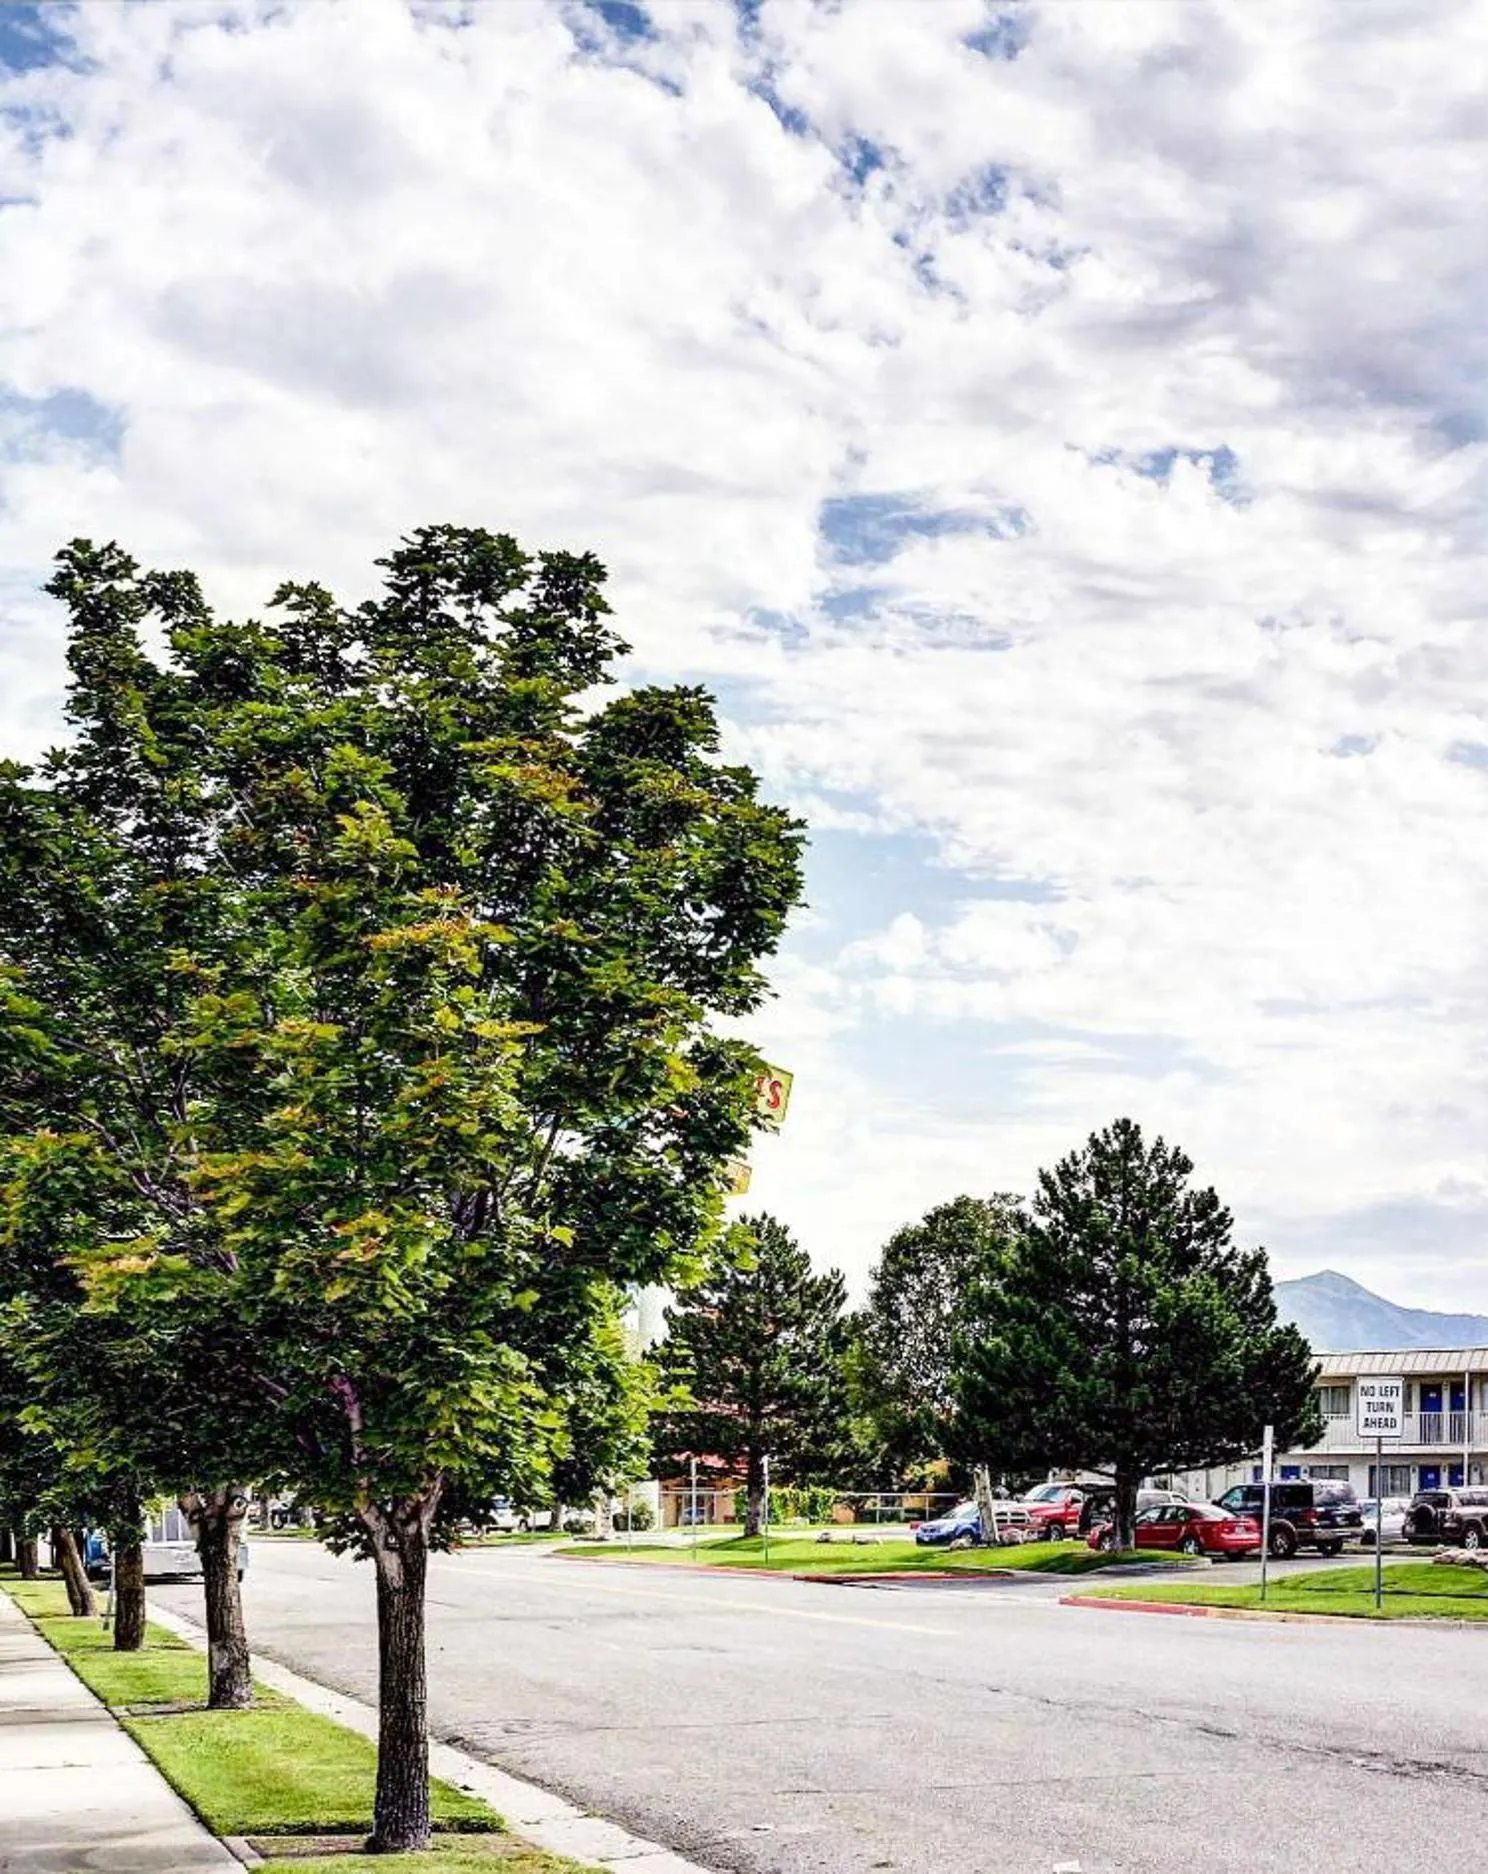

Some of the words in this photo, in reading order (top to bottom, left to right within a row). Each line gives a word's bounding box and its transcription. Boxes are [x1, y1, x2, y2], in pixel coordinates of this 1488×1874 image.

[1360, 1385, 1376, 1397] NO
[1379, 1385, 1400, 1397] LEFT
[1366, 1401, 1395, 1413] TURN
[1362, 1417, 1397, 1429] AHEAD
